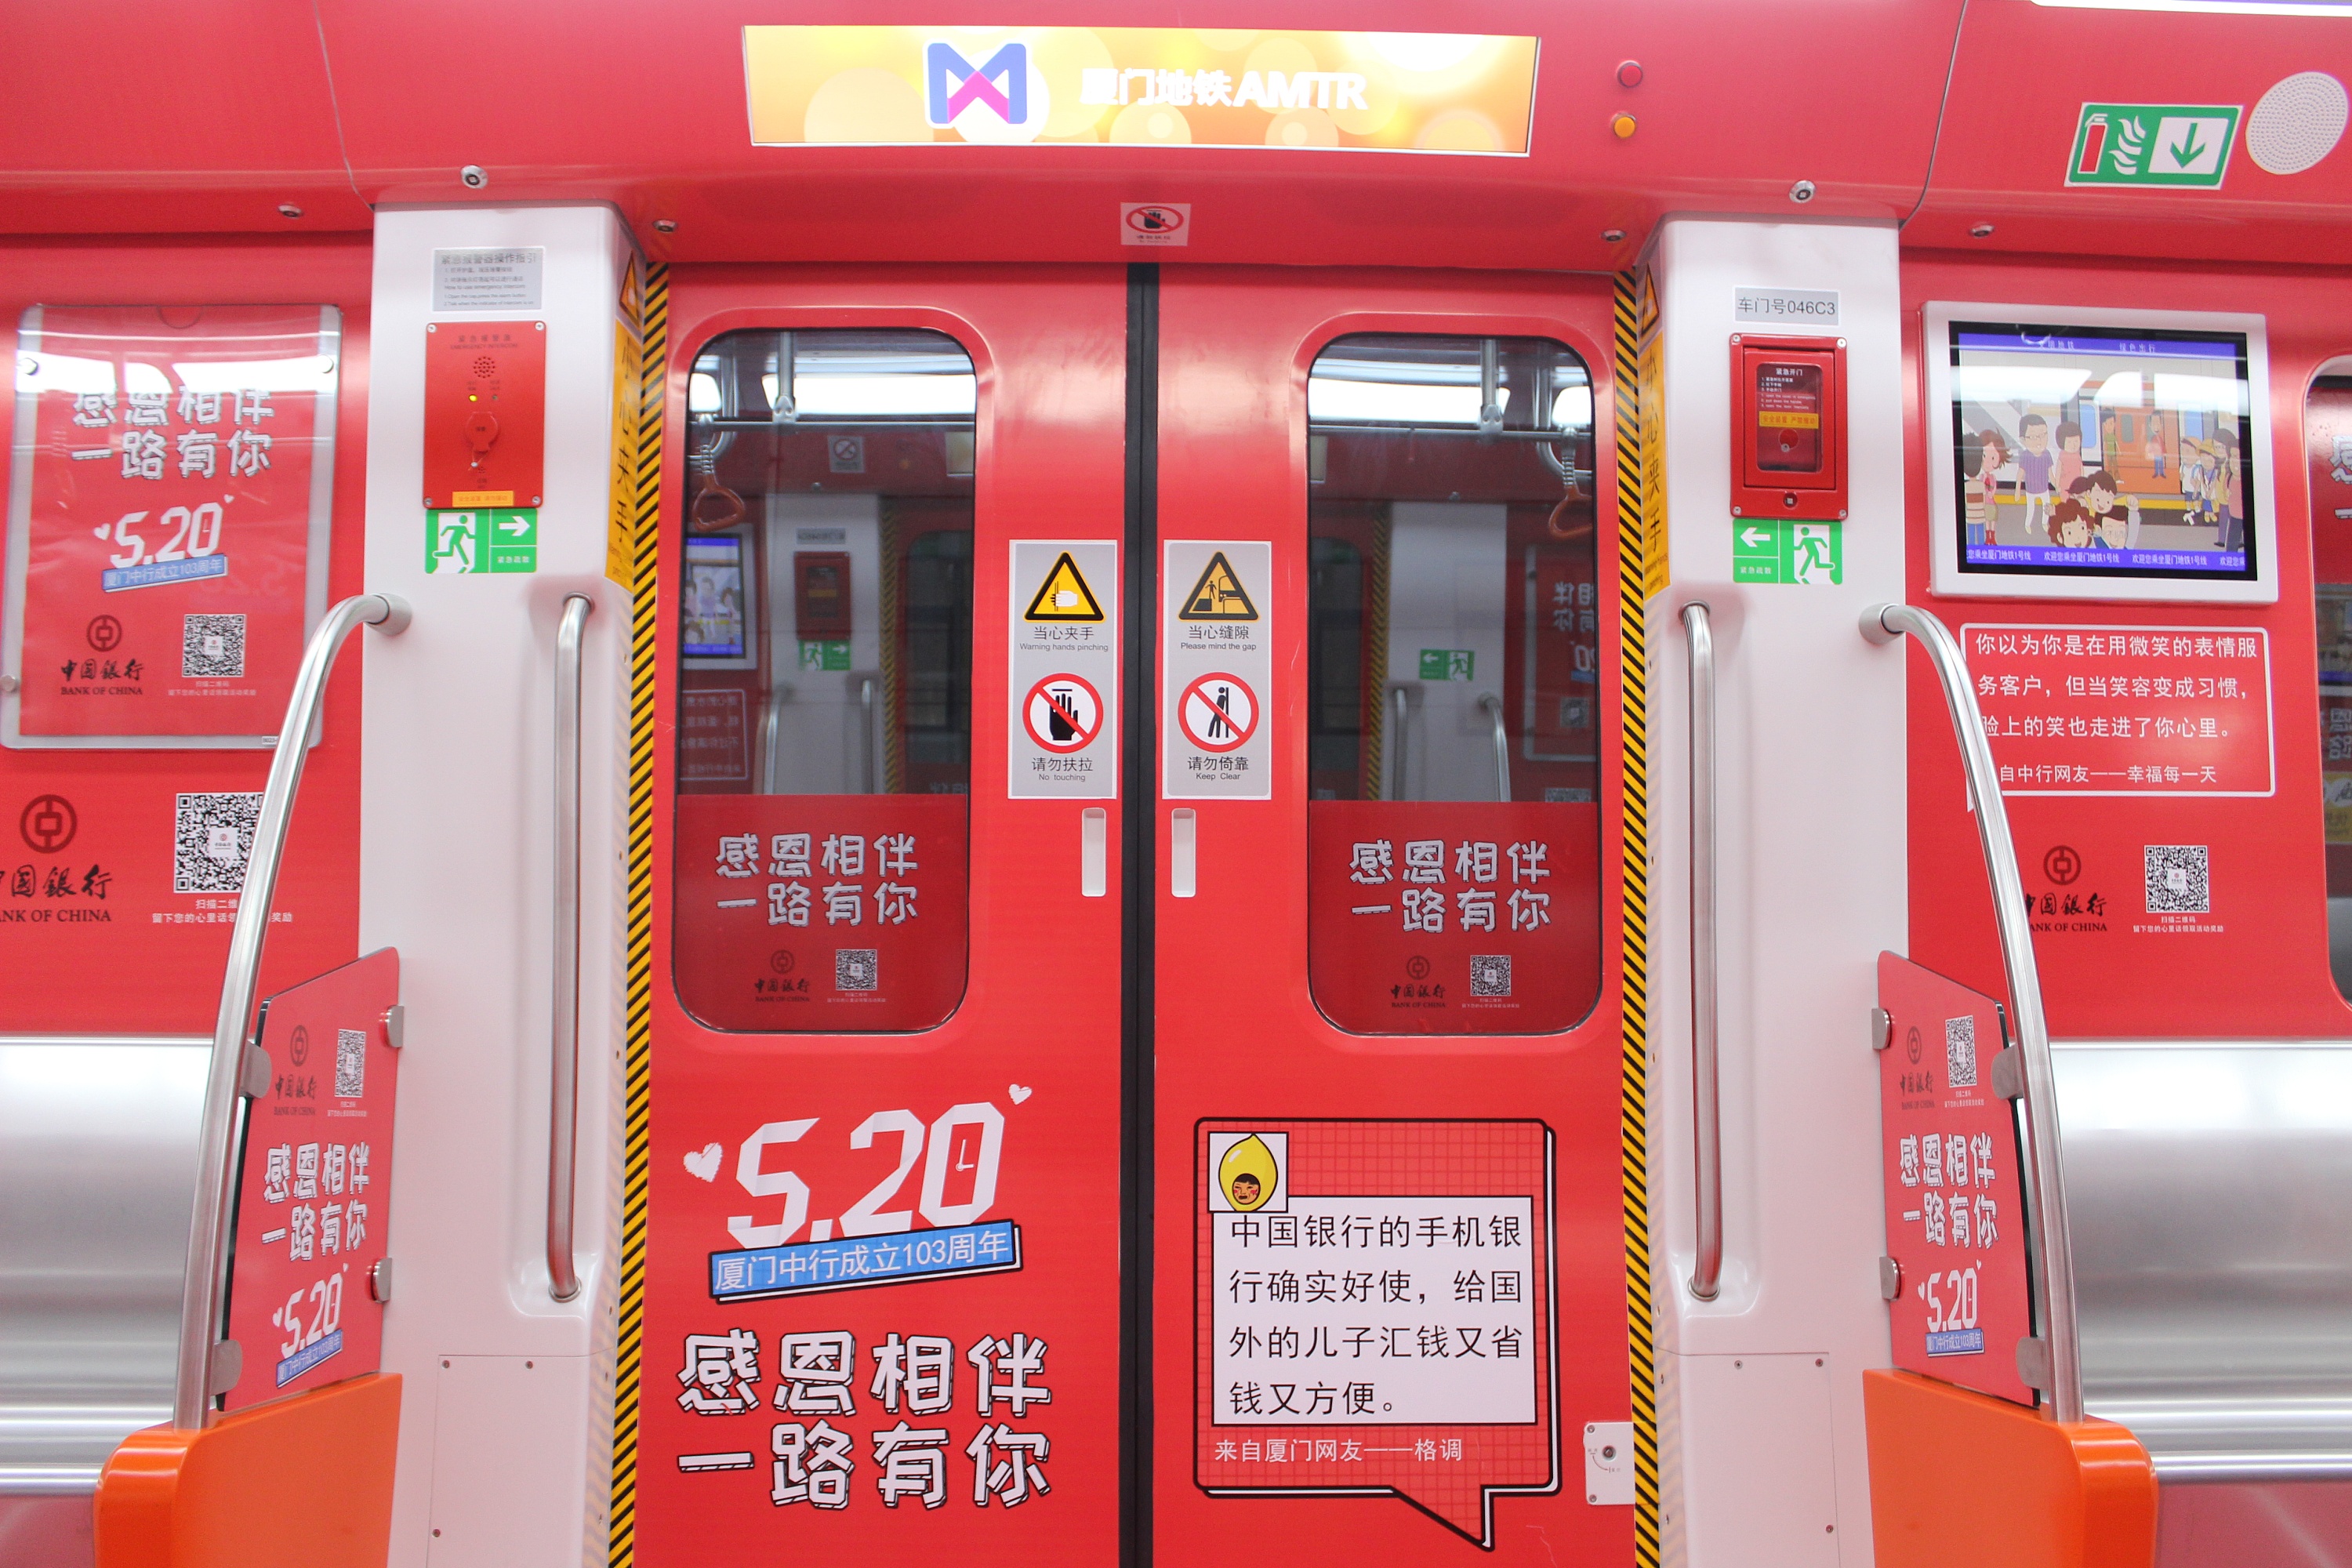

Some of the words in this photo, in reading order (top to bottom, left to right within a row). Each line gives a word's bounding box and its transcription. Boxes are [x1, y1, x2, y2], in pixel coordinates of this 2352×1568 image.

[1737, 297, 1836, 315] 车门号046C3
[71, 429, 273, 480] 一路有你
[110, 502, 223, 568] 5.20
[1966, 550, 2031, 561] 您乘坐厦门地铁1号线
[2044, 551, 2120, 564] 欢迎您乘坐厦门地铁1号线
[2132, 554, 2208, 565] 欢迎您乘坐厦门地铁1号线
[1019, 642, 1051, 652] Warning
[1052, 642, 1076, 651] hands
[1077, 642, 1109, 652] pinching
[1033, 626, 1094, 641] 当心夹手
[1181, 642, 1207, 651] Please
[1228, 642, 1241, 651] the
[1242, 643, 1257, 652] gap
[1188, 625, 1250, 640] 当心缝隙
[1976, 633, 2258, 659] 你以为你是在用微笑的表情服
[61, 687, 89, 695] BANK
[93, 687, 106, 695] OF
[111, 686, 143, 695] CHINA
[1978, 673, 2248, 699] 务客户，但当笑容变成习惯，
[1031, 757, 1094, 772] 请勿扶拉
[1054, 773, 1086, 782] touching
[1188, 756, 1249, 771] 请勿倚靠
[1196, 772, 1216, 782] Keep
[1999, 764, 2217, 784] 自中行网友——幸福每一天
[715, 832, 918, 878] 感恩相伴
[1349, 839, 1551, 884] 感恩相伴
[0, 909, 26, 922] NK
[31, 909, 52, 922] OF
[56, 909, 111, 922] CHINA
[195, 898, 238, 909] 扫描二维
[717, 880, 918, 927] 一路有你
[1350, 887, 1551, 934] 一路有你
[2030, 923, 2052, 931] ANK
[2054, 923, 2068, 931] OF
[2071, 923, 2107, 932] CHINA
[263, 1141, 371, 1203] 感恩相伴
[727, 1102, 1005, 1249] 5.20
[1899, 1132, 1996, 1188] 感恩相伴
[261, 1199, 368, 1261] 一路有你
[1230, 1214, 1523, 1249] 中国银行的手机银
[1903, 1190, 1999, 1250] 一路有你
[714, 1230, 1010, 1290] 厦门中行成立103周年
[1229, 1269, 1523, 1304] 行确实好使，给国
[1927, 1267, 1977, 1333] 5.20
[281, 1272, 343, 1359] 5.20
[1229, 1325, 1523, 1359] 外的儿子汇钱又省
[1926, 1333, 1982, 1352] 厦门中行成立103周年
[677, 1327, 1053, 1417] 感恩相伴
[1229, 1381, 1396, 1415] 钱又方便。
[677, 1419, 1053, 1510] 一路有你
[1214, 1438, 1463, 1463] 来自厦门网友——格调
